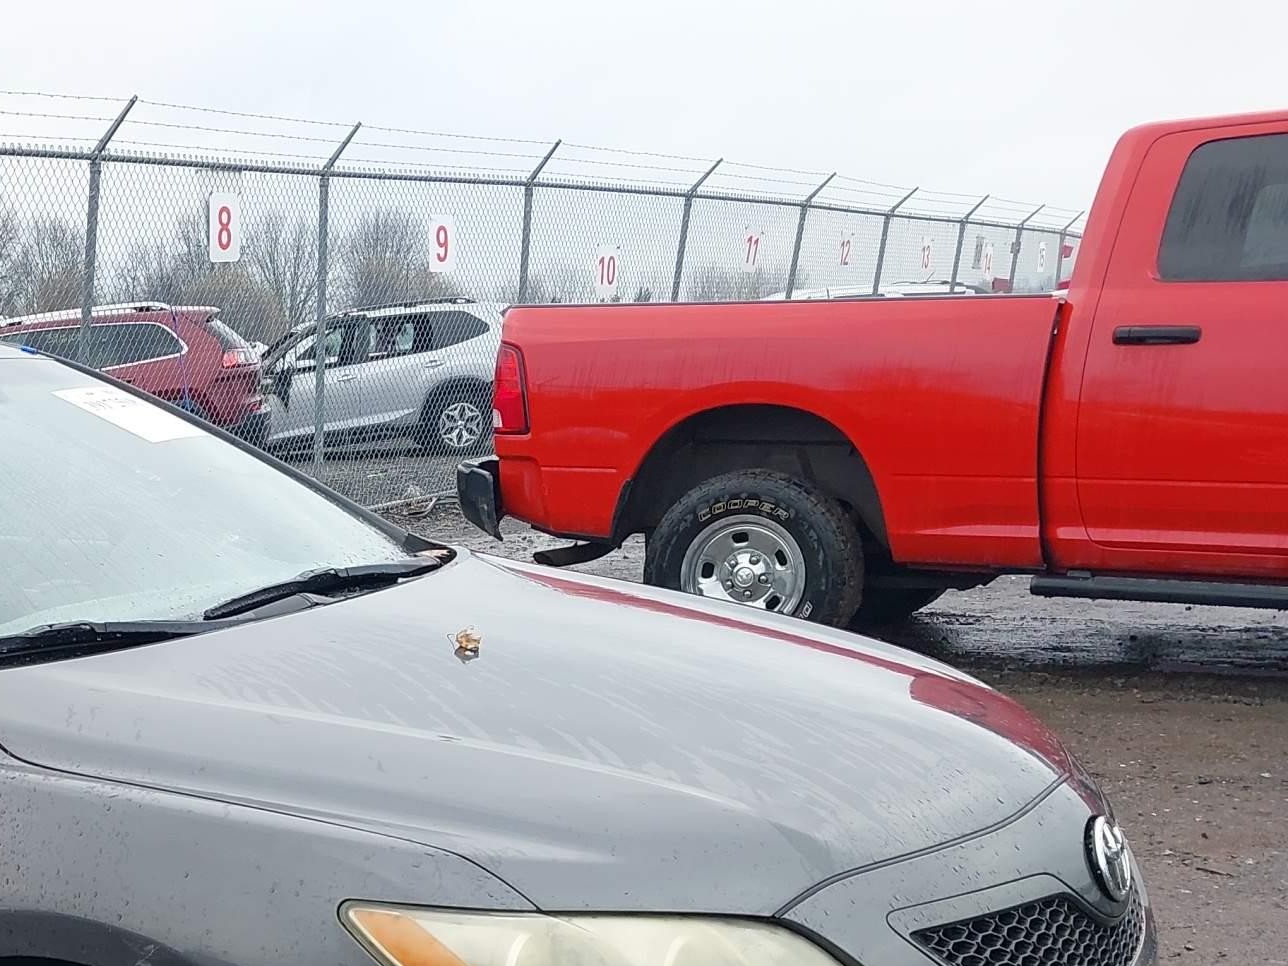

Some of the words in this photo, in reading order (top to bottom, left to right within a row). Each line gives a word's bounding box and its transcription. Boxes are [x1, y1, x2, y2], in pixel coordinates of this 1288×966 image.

[217, 205, 232, 251] 8
[435, 225, 449, 263] 9
[745, 234, 760, 266] 11
[839, 239, 852, 266] 12
[921, 245, 931, 269] 13
[598, 255, 616, 286] 10
[983, 252, 993, 274] 14
[698, 498, 790, 522] COOPER
